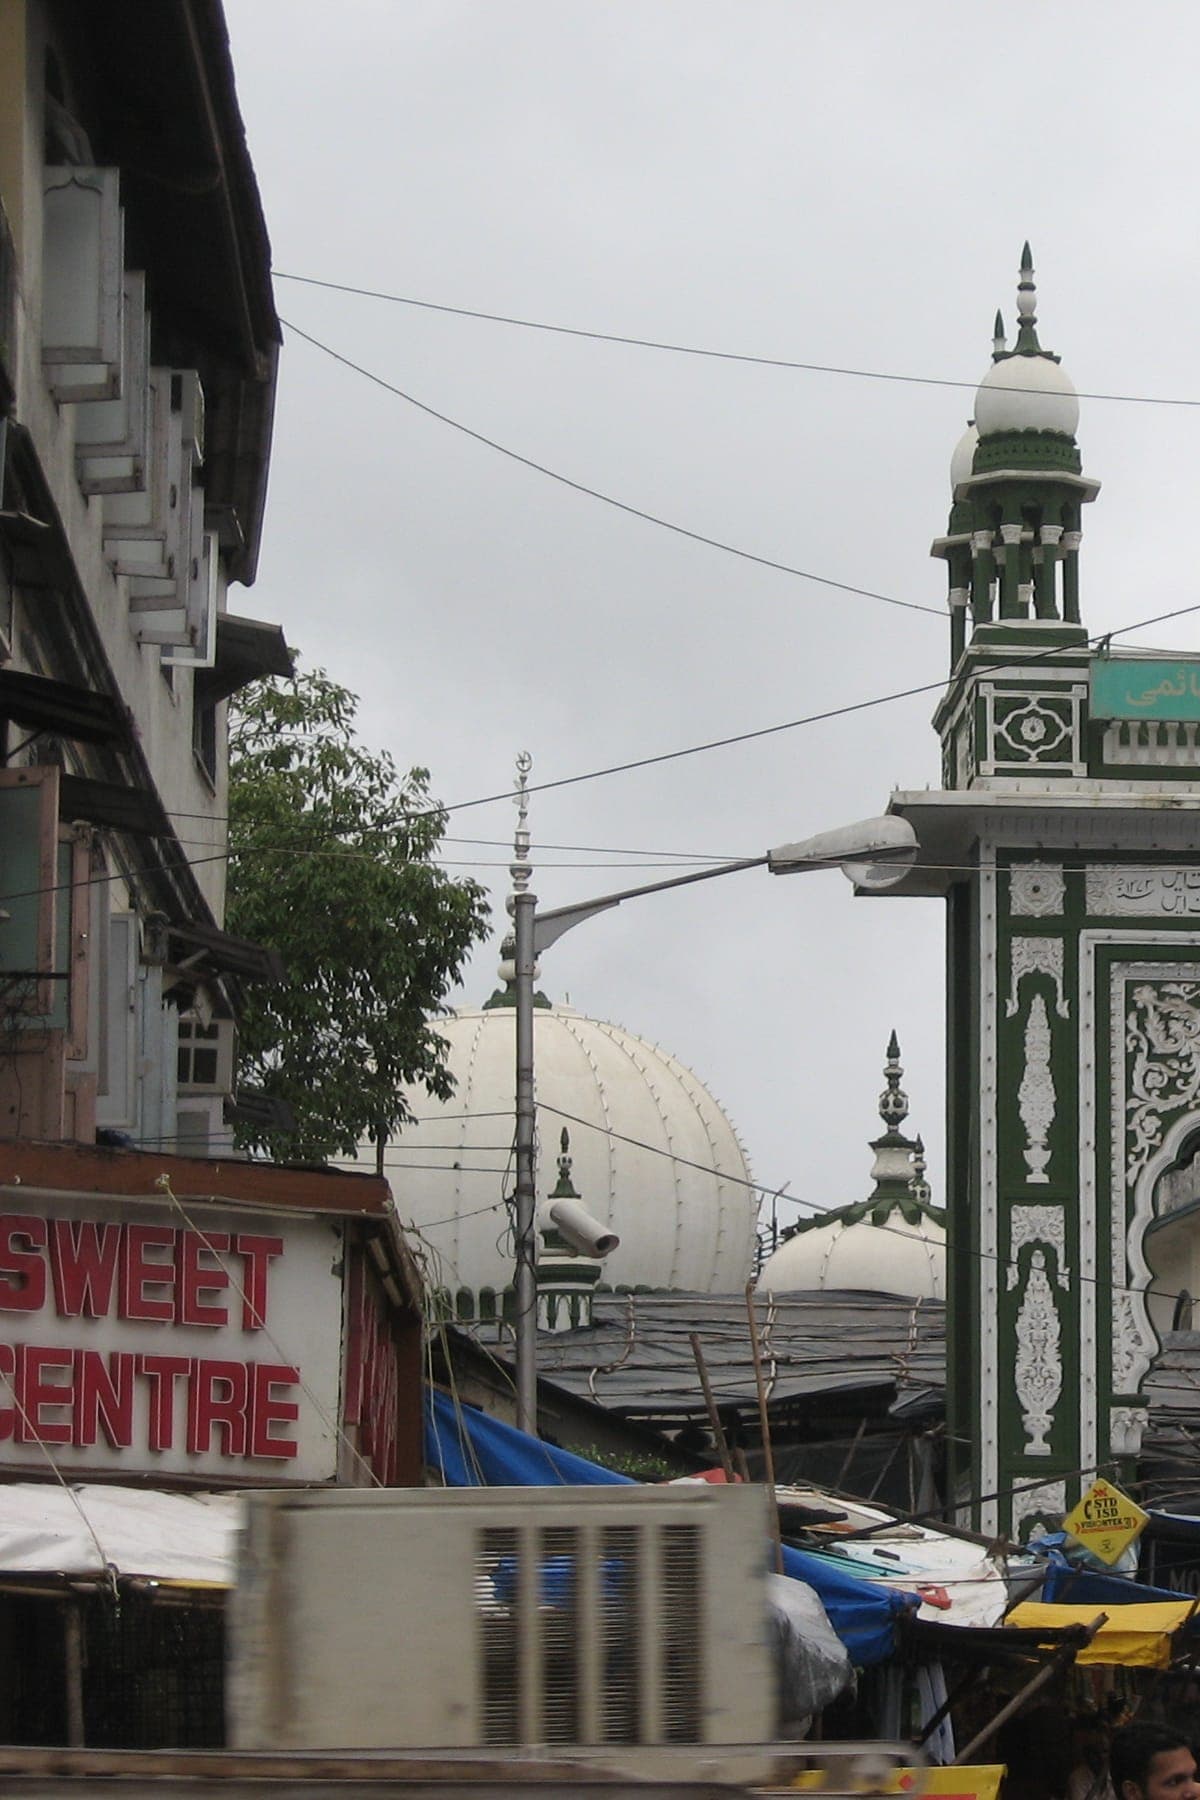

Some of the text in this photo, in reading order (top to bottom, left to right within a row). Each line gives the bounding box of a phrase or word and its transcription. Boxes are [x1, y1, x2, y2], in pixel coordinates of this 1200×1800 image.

[0, 1213, 284, 1331] SWEET
[1093, 1496, 1118, 1509] STD
[1096, 1508, 1119, 1519] ISD
